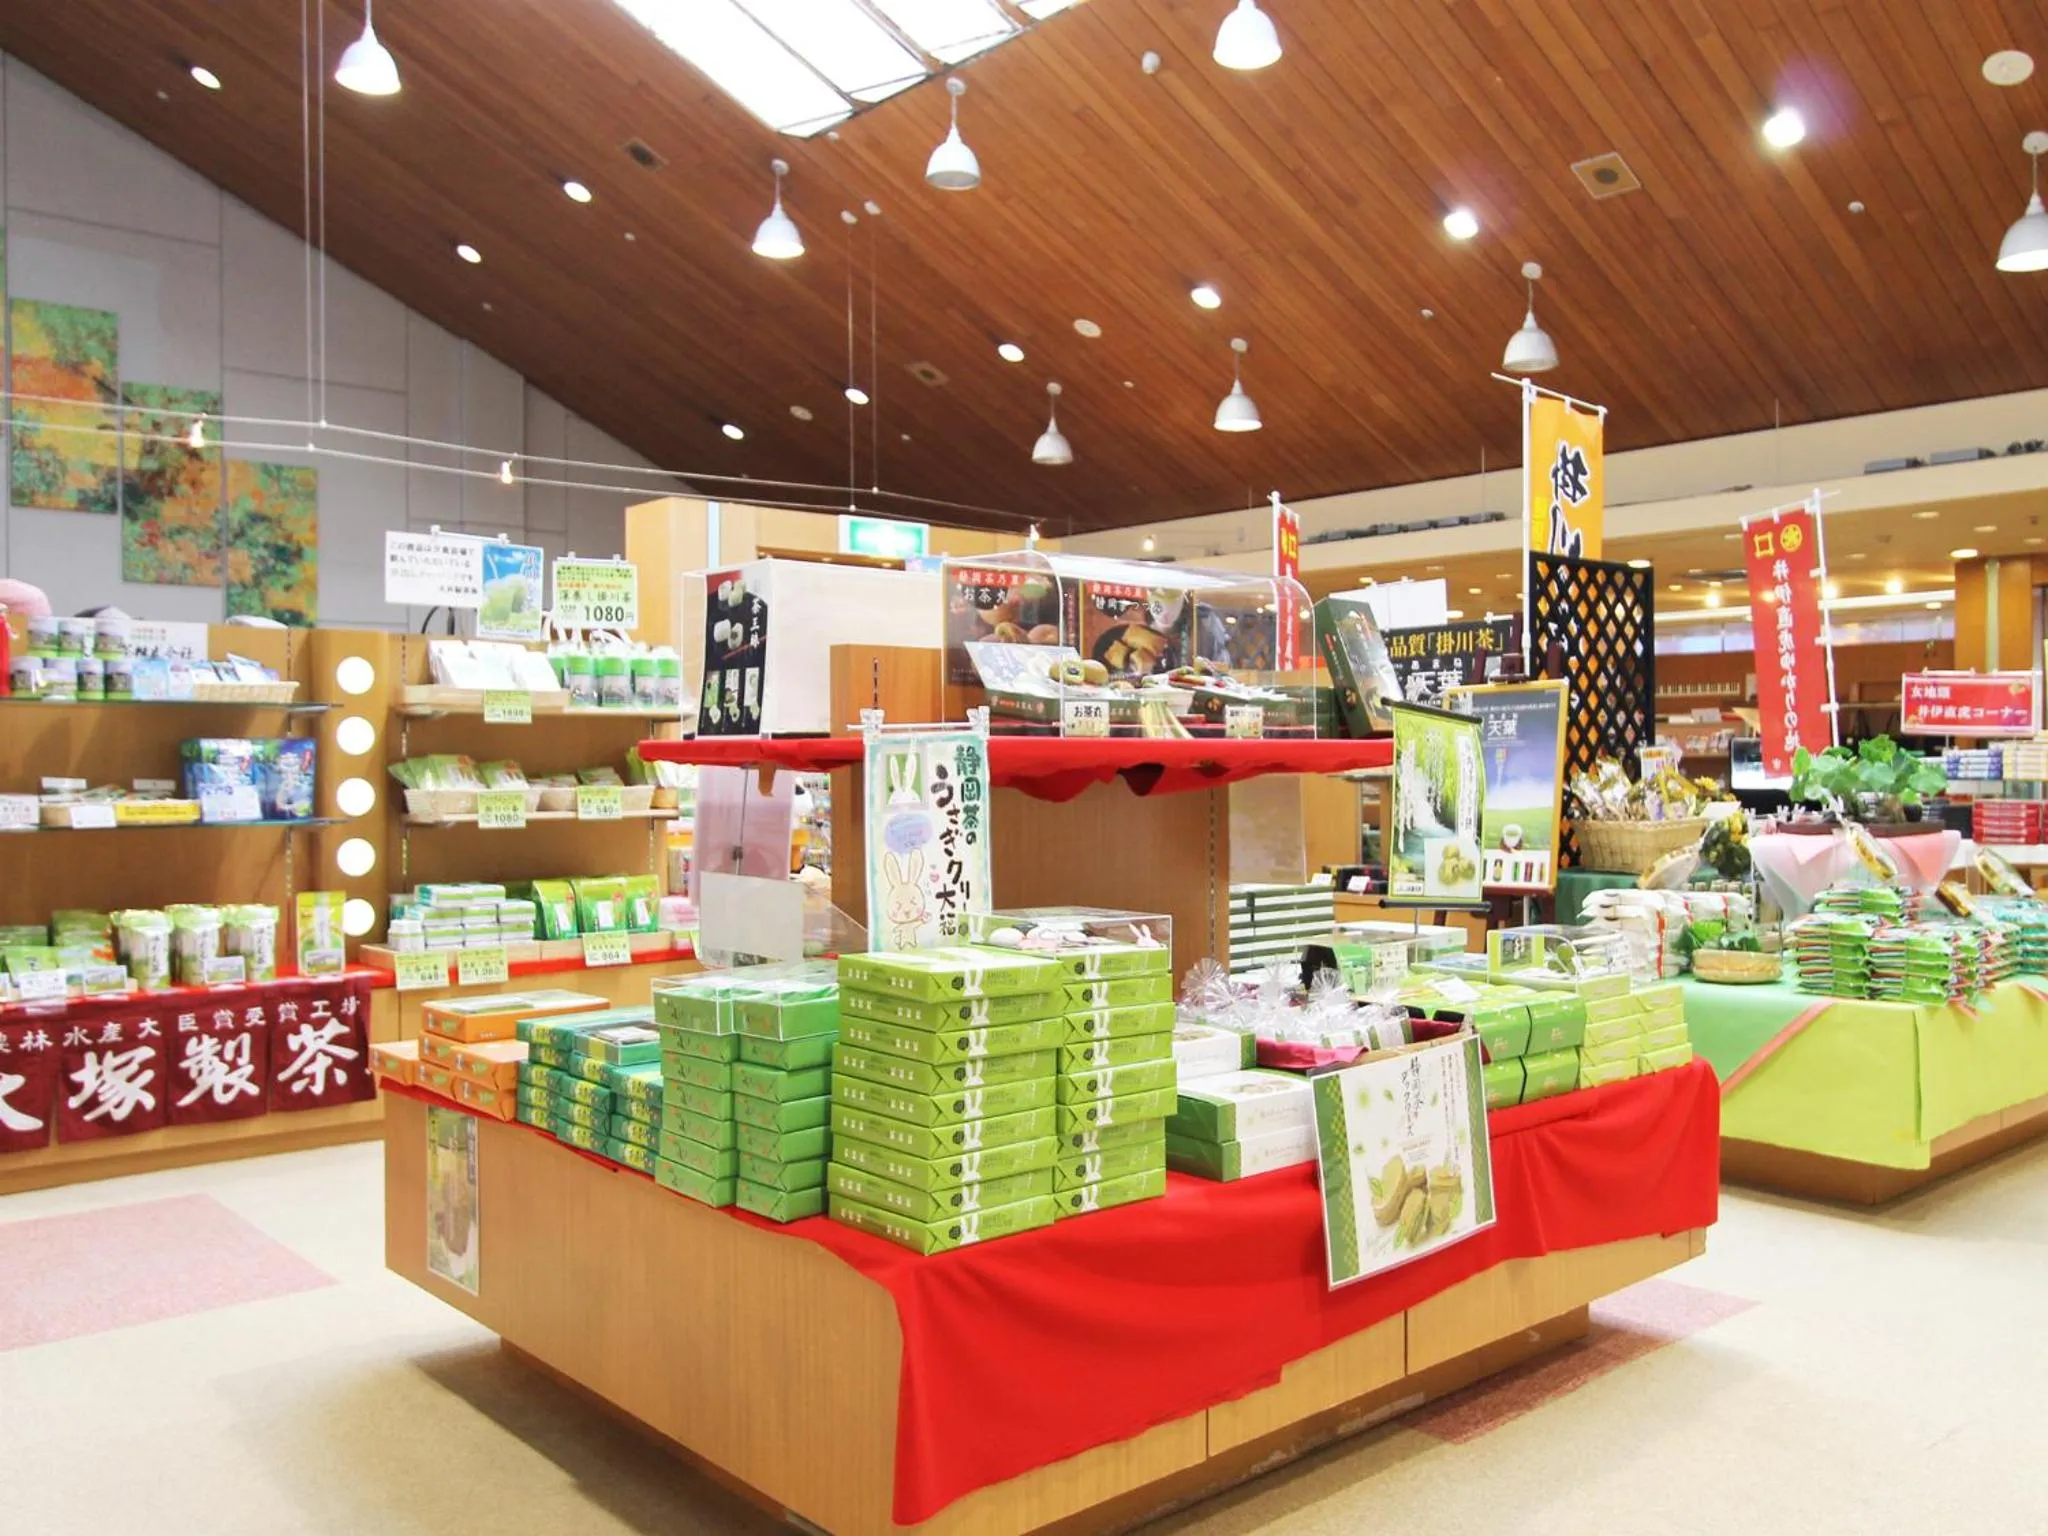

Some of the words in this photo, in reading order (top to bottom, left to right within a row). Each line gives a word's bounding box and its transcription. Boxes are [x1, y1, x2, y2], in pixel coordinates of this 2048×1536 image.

[1383, 627, 1505, 659] 品質「掛川茶」
